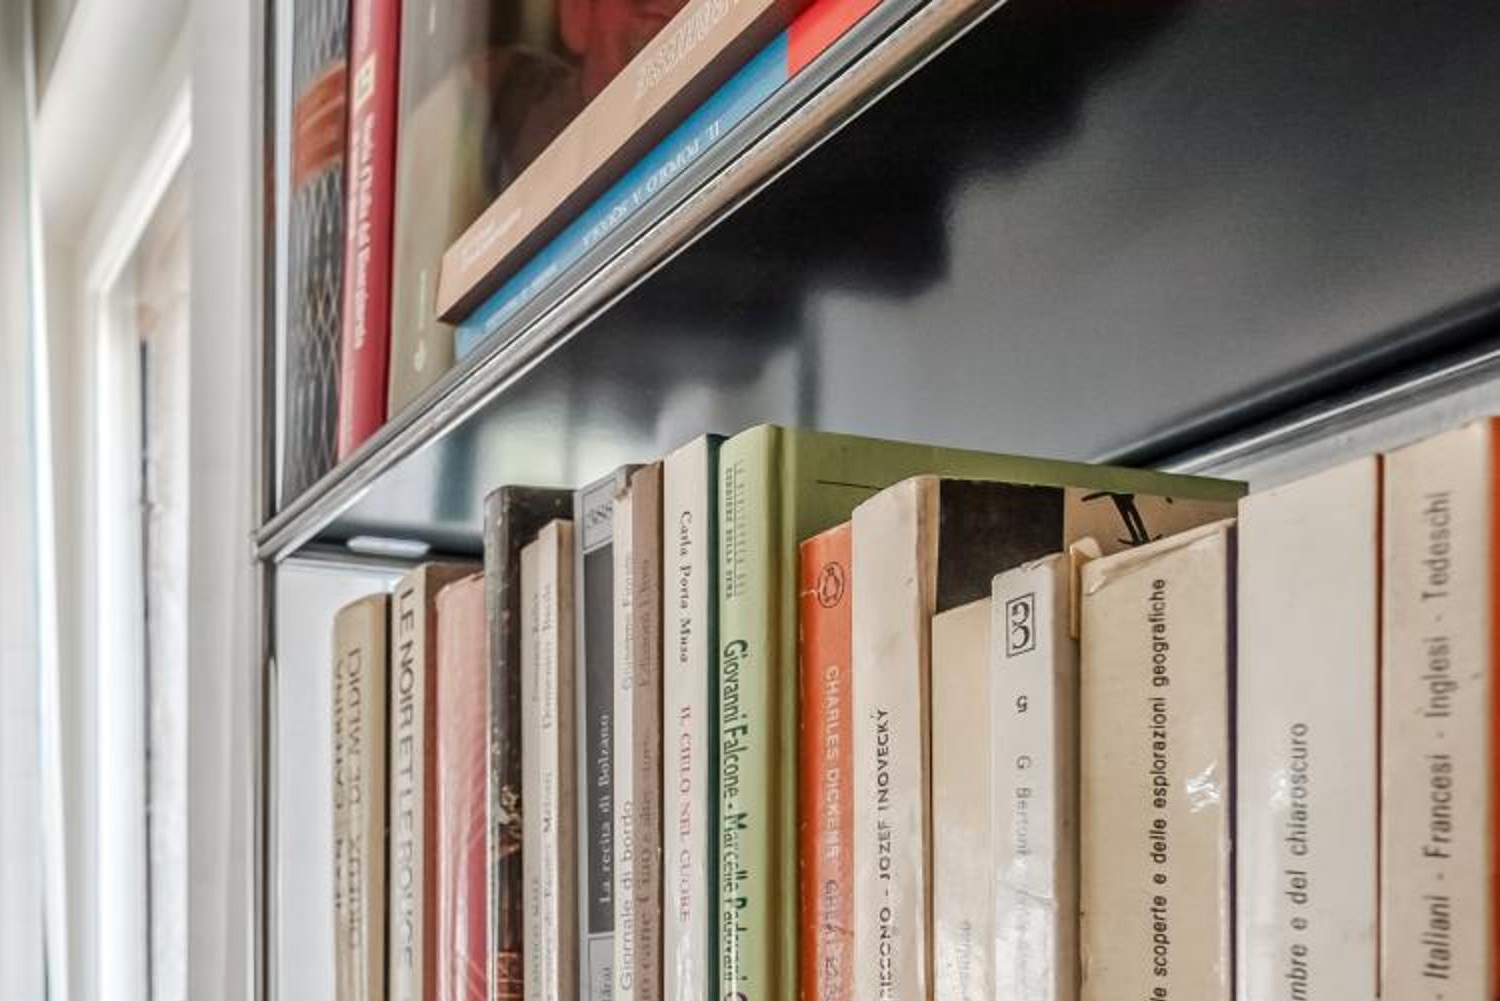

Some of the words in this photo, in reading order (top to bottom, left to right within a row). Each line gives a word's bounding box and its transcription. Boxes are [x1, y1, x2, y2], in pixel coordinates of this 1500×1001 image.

[679, 510, 693, 557] Carla
[1420, 491, 1451, 603] Tedeschi
[399, 587, 415, 639] LE
[679, 564, 693, 610] Porta
[679, 617, 693, 664] Musa
[1148, 578, 1170, 687] geografiche
[399, 640, 415, 729] NOIR
[723, 639, 748, 723] Giovanni
[1420, 635, 1458, 719] Inglesi
[679, 704, 692, 729] IL
[824, 664, 842, 764] CHARLES
[399, 734, 414, 783] ET
[597, 714, 612, 788] Bolzano
[723, 724, 748, 799] Falcone
[1148, 696, 1171, 809] esplorazioni
[398, 787, 414, 833] LE
[598, 794, 612, 812] di
[1284, 722, 1309, 857] chiaroscuro
[1420, 754, 1452, 859] Francesi
[599, 821, 612, 872] recita
[620, 800, 633, 862] bordo
[679, 802, 692, 839] NEL
[877, 820, 892, 881] JOZEF
[1149, 818, 1168, 865] delle
[599, 879, 612, 903] La
[620, 871, 633, 890] di
[679, 849, 692, 926] CUORE
[1155, 873, 1168, 885] e
[1284, 870, 1309, 905] del
[619, 900, 633, 991] Giornale
[1150, 895, 1170, 977] scoperte
[1291, 917, 1309, 931] e
[1419, 894, 1451, 980] Italiani
